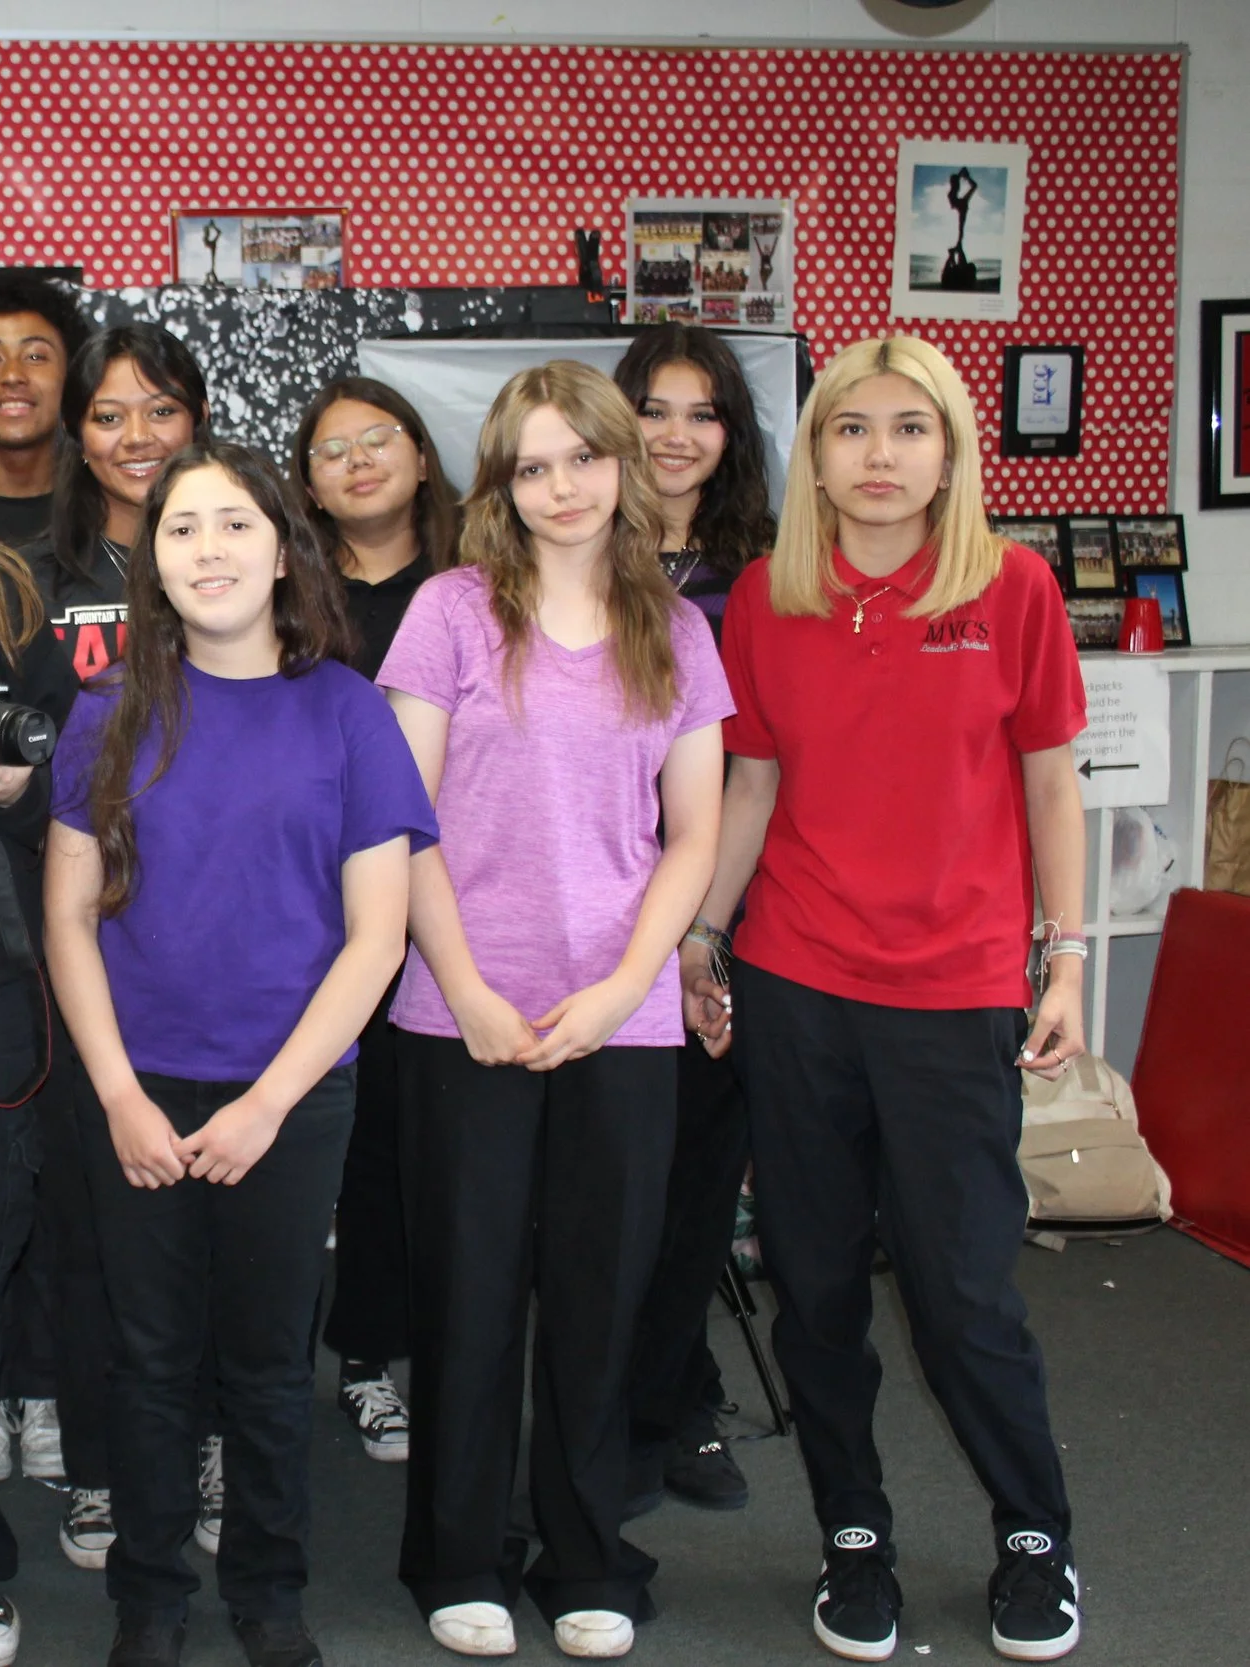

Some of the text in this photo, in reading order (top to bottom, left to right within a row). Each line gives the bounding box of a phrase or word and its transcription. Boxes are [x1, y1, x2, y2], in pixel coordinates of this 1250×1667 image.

[74, 610, 117, 625] MOUNTAIN
[922, 620, 990, 643] MVCS
[1085, 681, 1123, 694] ckpacks
[1107, 697, 1121, 707] be
[1106, 711, 1138, 723] neatly
[28, 734, 48, 743] Canon
[1118, 728, 1136, 738] the
[1075, 744, 1123, 757] two signs!
